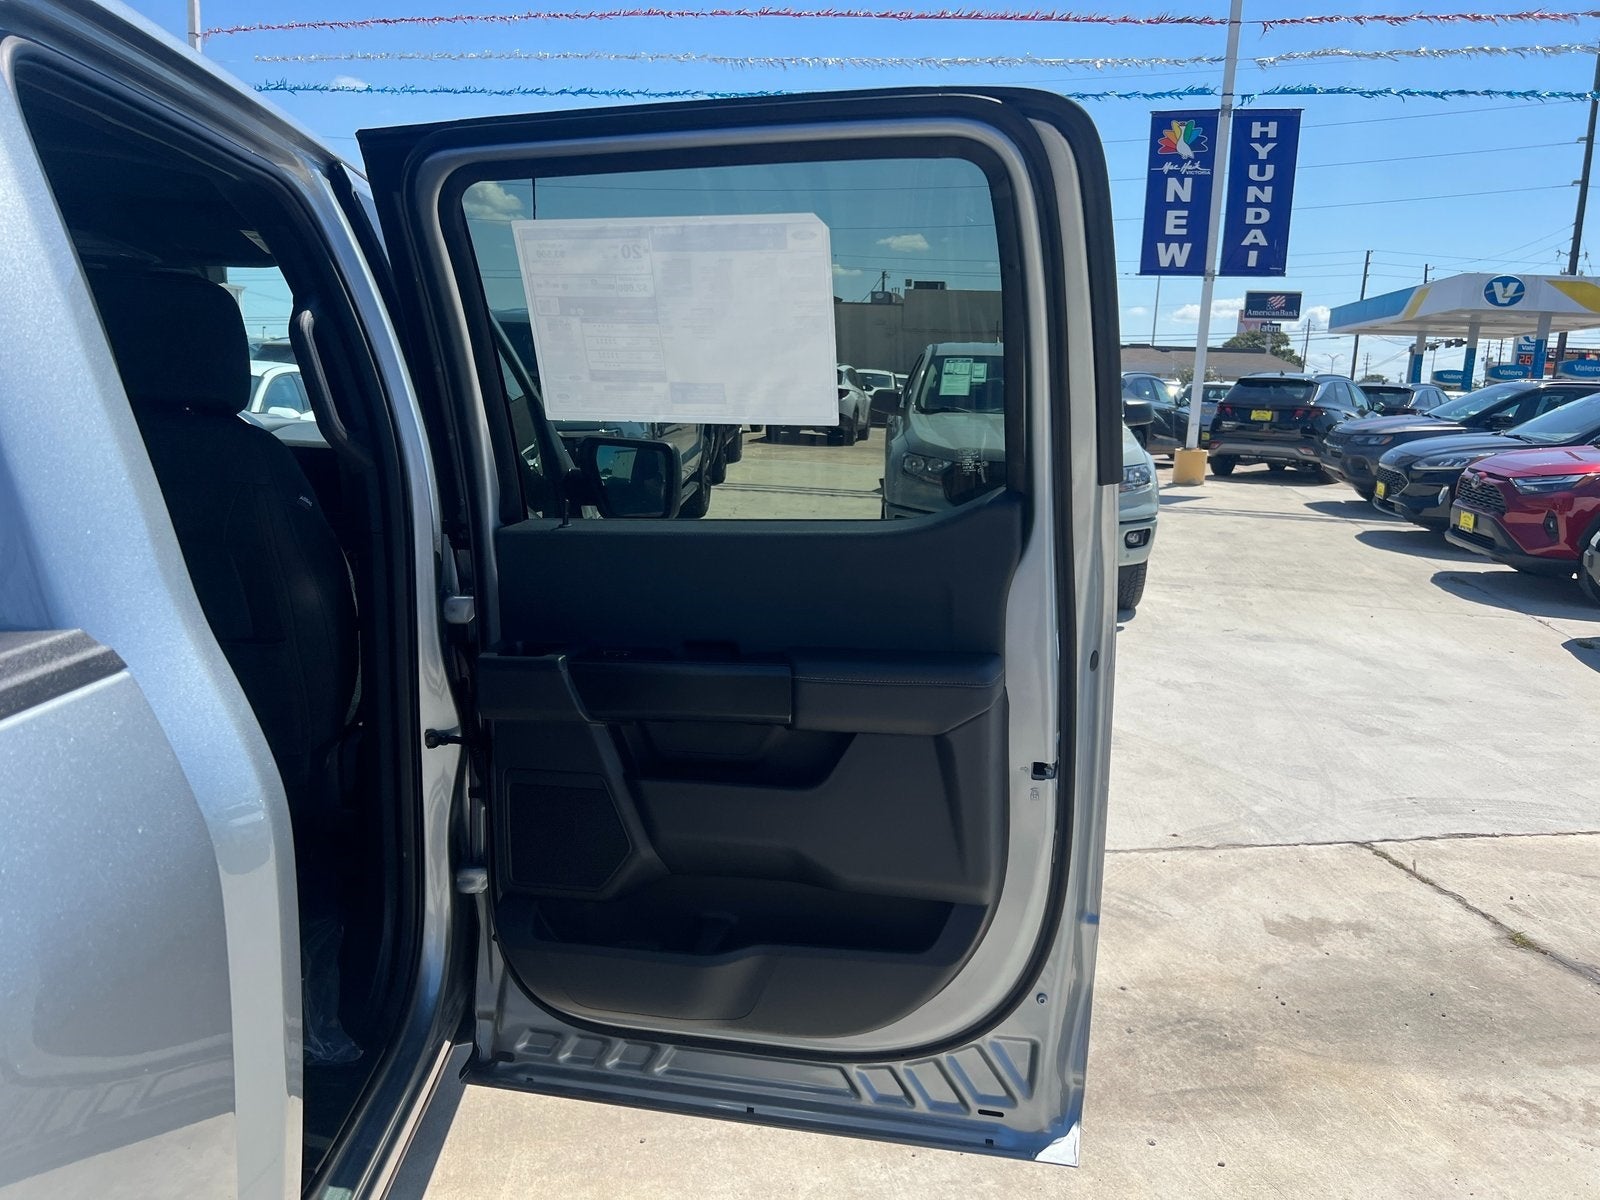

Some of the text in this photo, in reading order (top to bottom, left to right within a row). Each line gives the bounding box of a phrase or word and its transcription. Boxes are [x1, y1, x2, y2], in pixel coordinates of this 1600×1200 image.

[1157, 177, 1193, 268] NEW
[1241, 121, 1278, 267] HYUNDAI
[1260, 323, 1280, 332] atm
